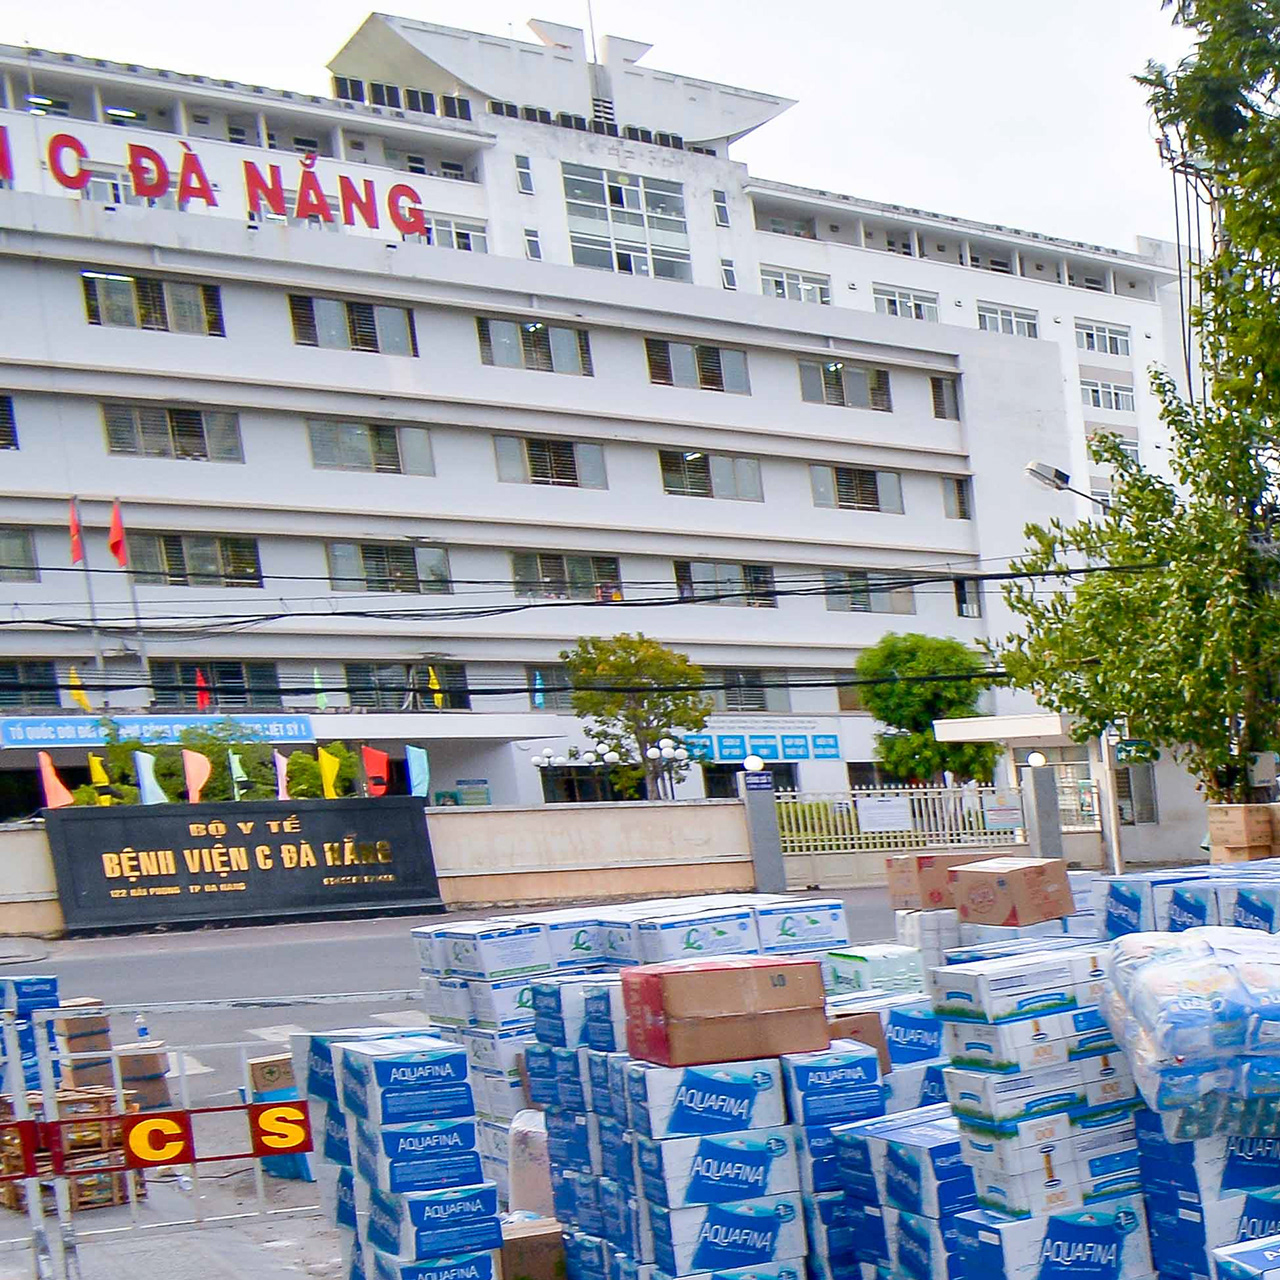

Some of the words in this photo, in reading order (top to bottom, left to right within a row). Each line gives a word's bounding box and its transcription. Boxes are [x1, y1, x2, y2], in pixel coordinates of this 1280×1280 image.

[47, 133, 92, 191] C
[127, 140, 218, 208] ĐÀ
[189, 818, 227, 840] BỘ
[236, 821, 255, 836] Y
[265, 814, 303, 835] TẾ
[100, 846, 177, 883] BỆNH
[181, 842, 250, 879] VIỆN
[254, 845, 274, 871] C
[279, 839, 318, 870] ĐÀ
[885, 1021, 941, 1050] AQUAFINA
[390, 1061, 456, 1084] AQUAFINA
[808, 1066, 867, 1087] AQUAFINA
[674, 1082, 750, 1120] AQUAFINA
[129, 1119, 185, 1161] C
[258, 1107, 306, 1148] S
[397, 1130, 464, 1153] AQUAFINA
[691, 1153, 765, 1189] AQUAFINA
[423, 1198, 487, 1221] AQUAFINA
[699, 1220, 775, 1254] AQUAFINA
[1039, 1238, 1118, 1273] AQUAFINA
